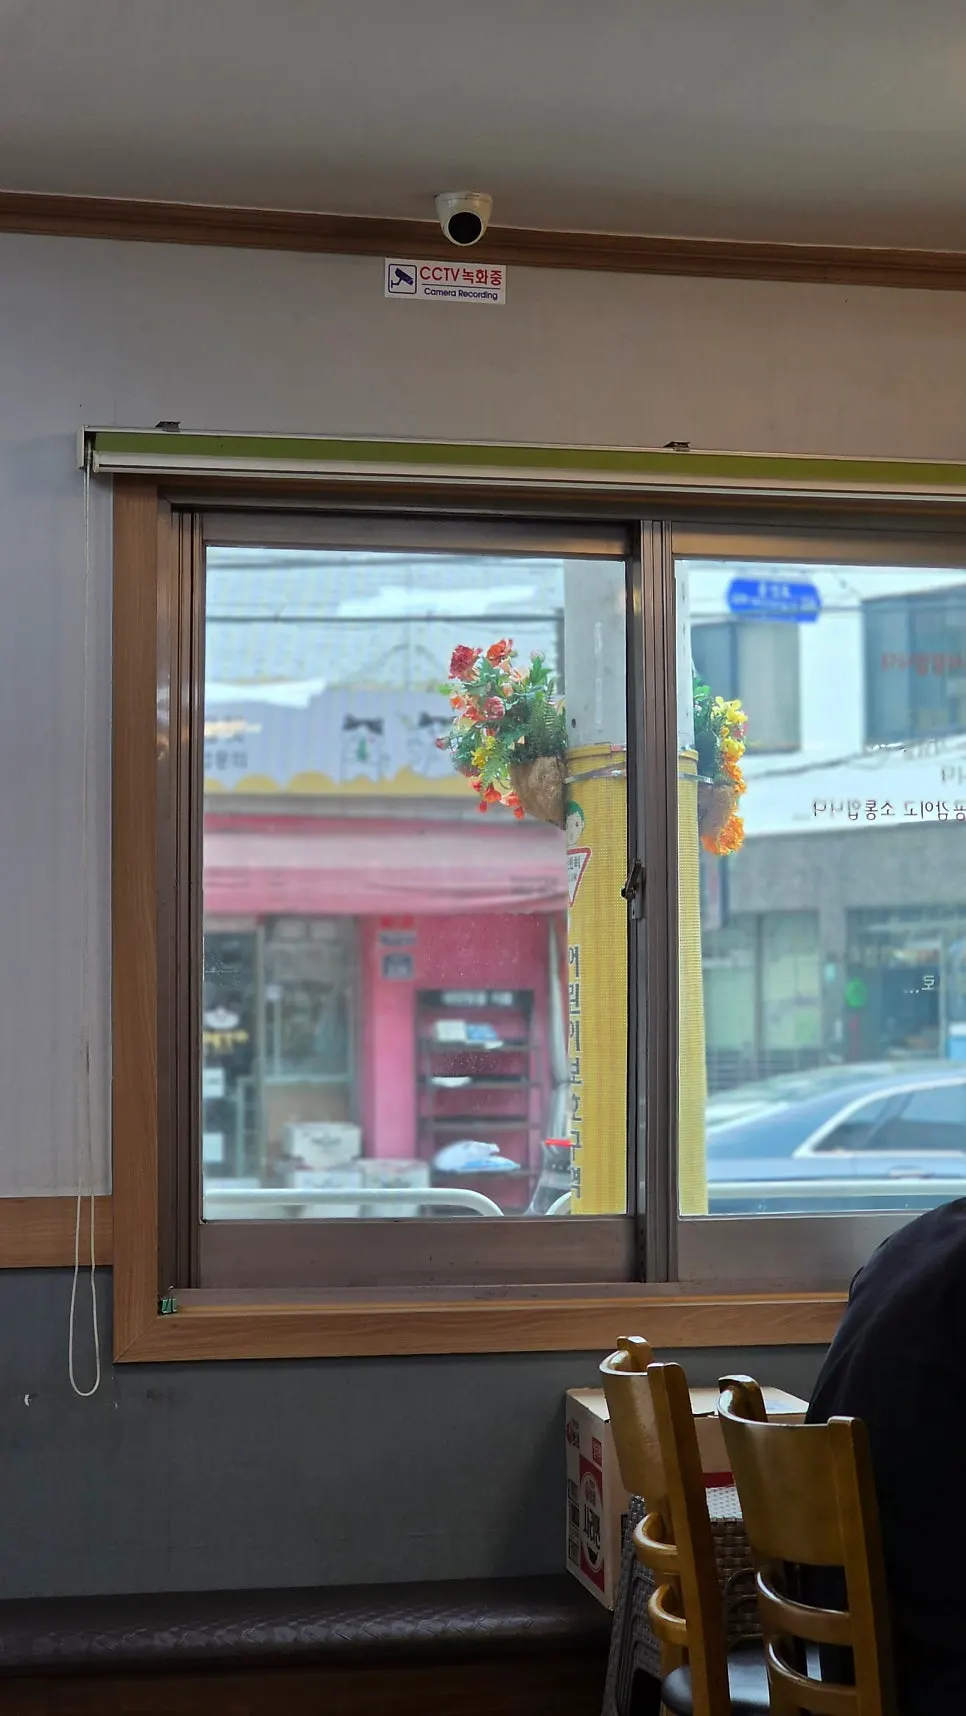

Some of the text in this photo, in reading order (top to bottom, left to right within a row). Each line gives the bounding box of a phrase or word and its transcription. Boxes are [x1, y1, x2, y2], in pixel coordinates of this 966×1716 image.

[420, 266, 502, 286] CCTV 녹화중
[424, 287, 498, 300] Camera Recording
